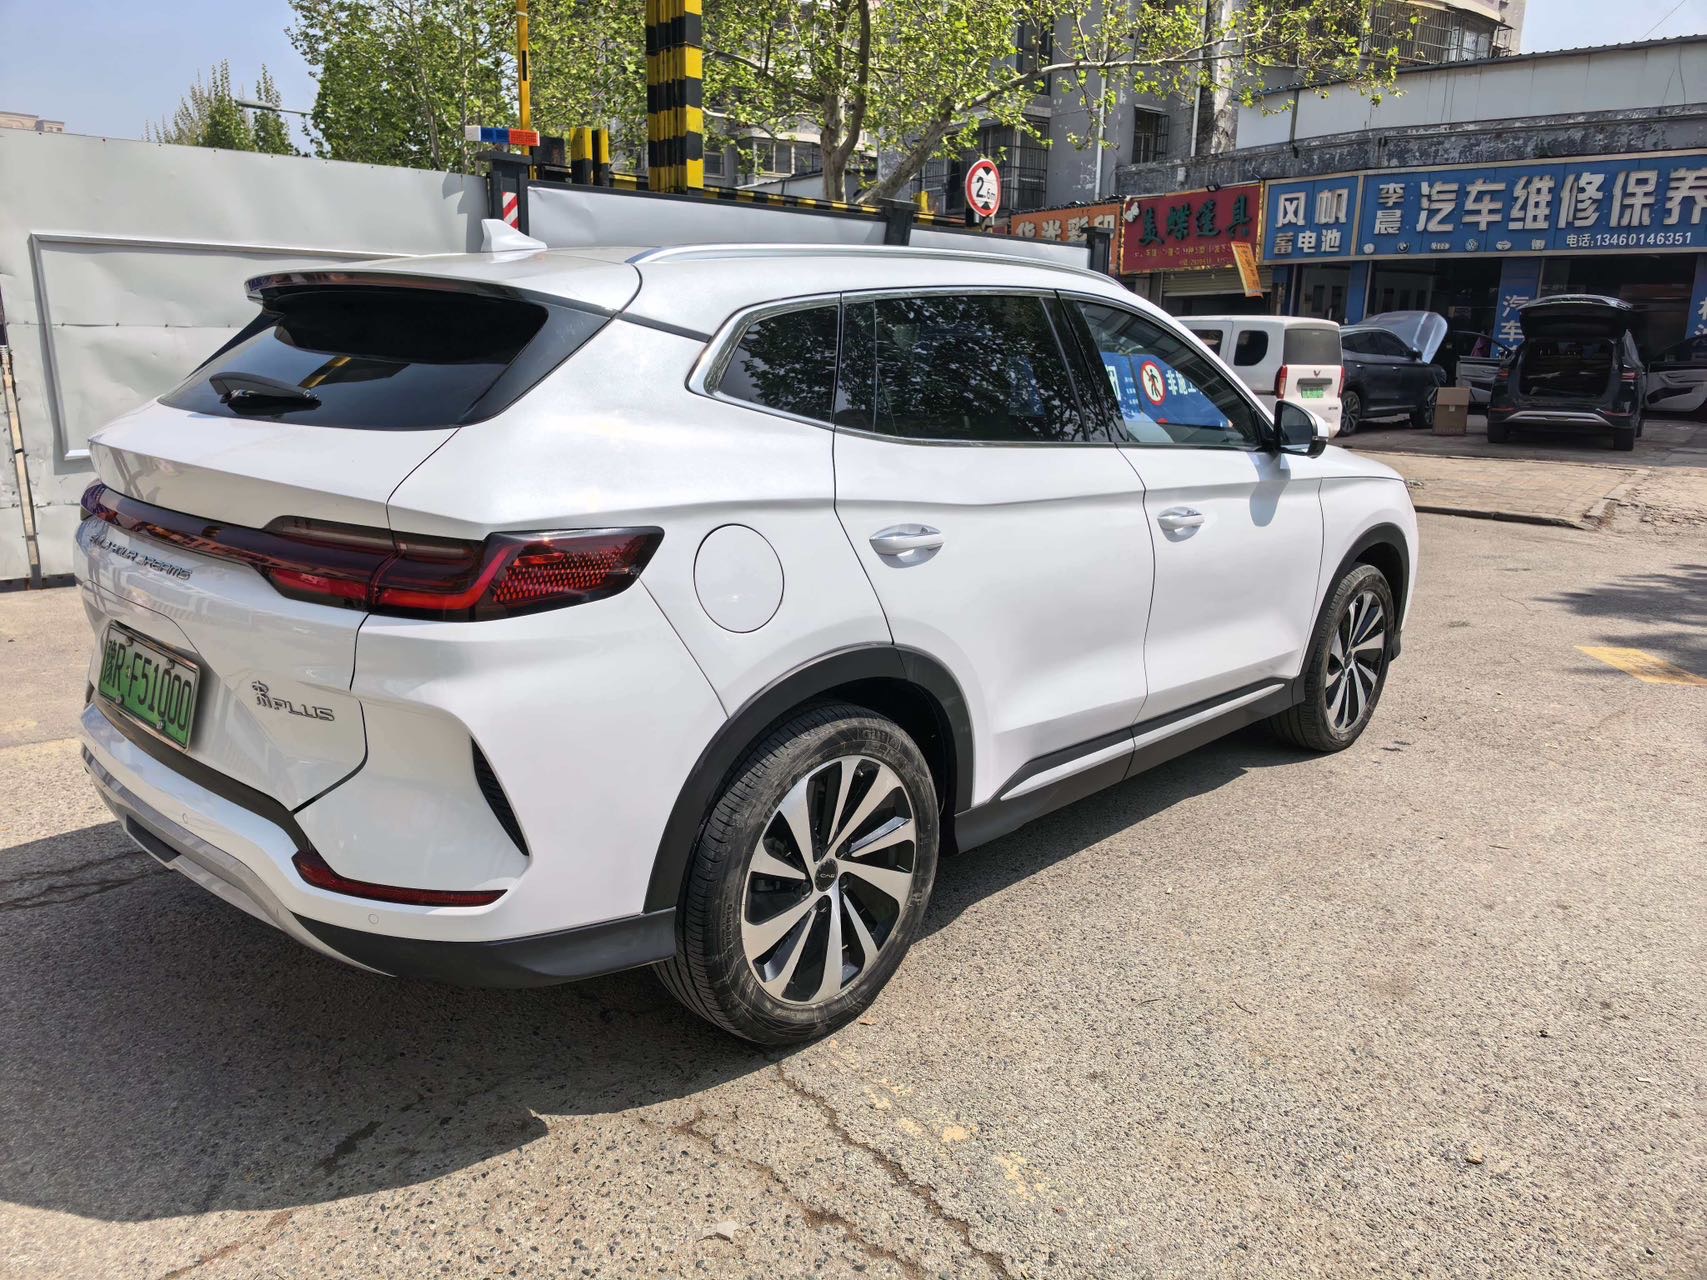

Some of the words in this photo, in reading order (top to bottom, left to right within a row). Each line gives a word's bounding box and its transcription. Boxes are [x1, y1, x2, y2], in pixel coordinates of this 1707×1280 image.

[1275, 187, 1350, 228] 风帆
[1373, 183, 1406, 235] 李晨
[1416, 167, 1707, 233] 汽车维修保养
[1273, 229, 1343, 255] 蓄电池
